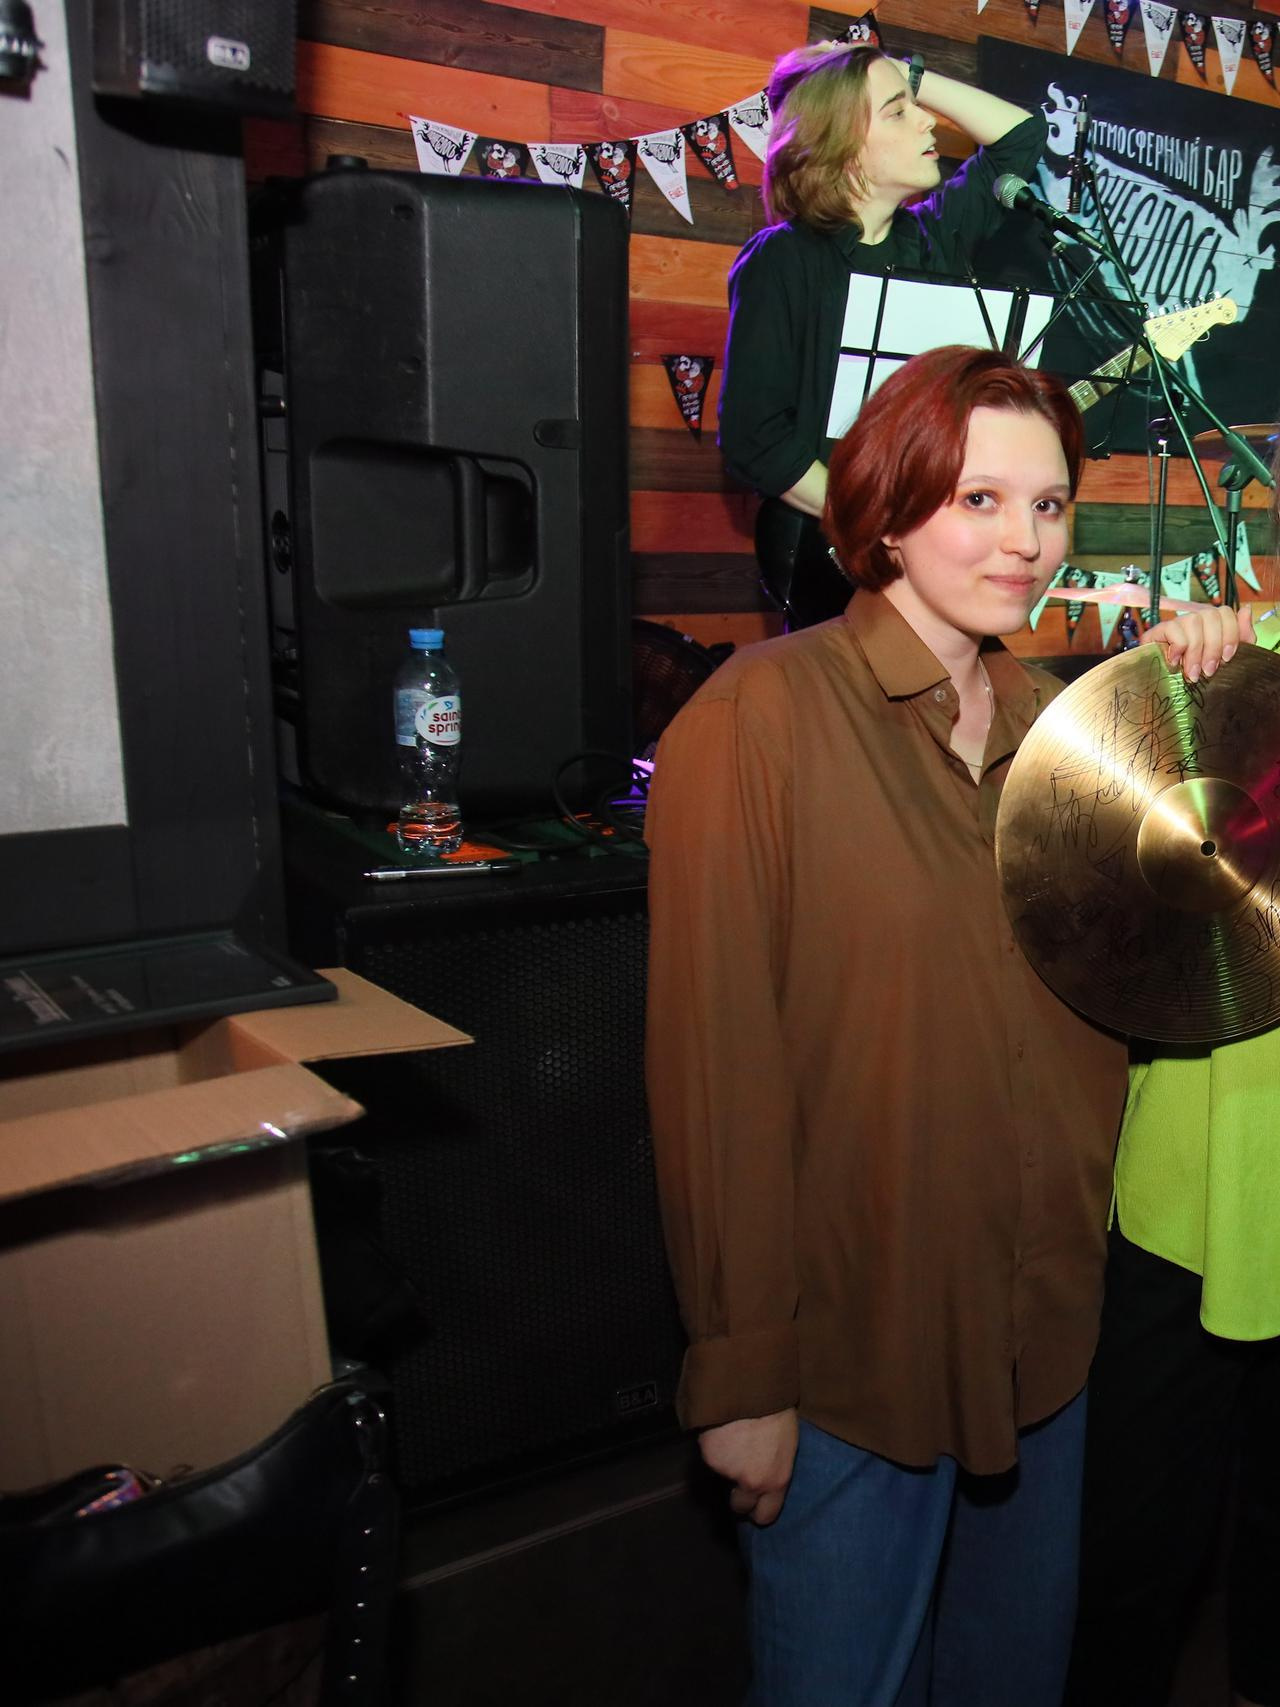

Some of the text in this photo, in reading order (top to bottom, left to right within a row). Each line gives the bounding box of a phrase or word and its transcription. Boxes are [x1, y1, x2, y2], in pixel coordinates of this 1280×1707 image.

[1203, 144, 1243, 210] БАР
[1078, 160, 1223, 306] ОНЕСЛОСЬ
[428, 722, 461, 736] sprin
